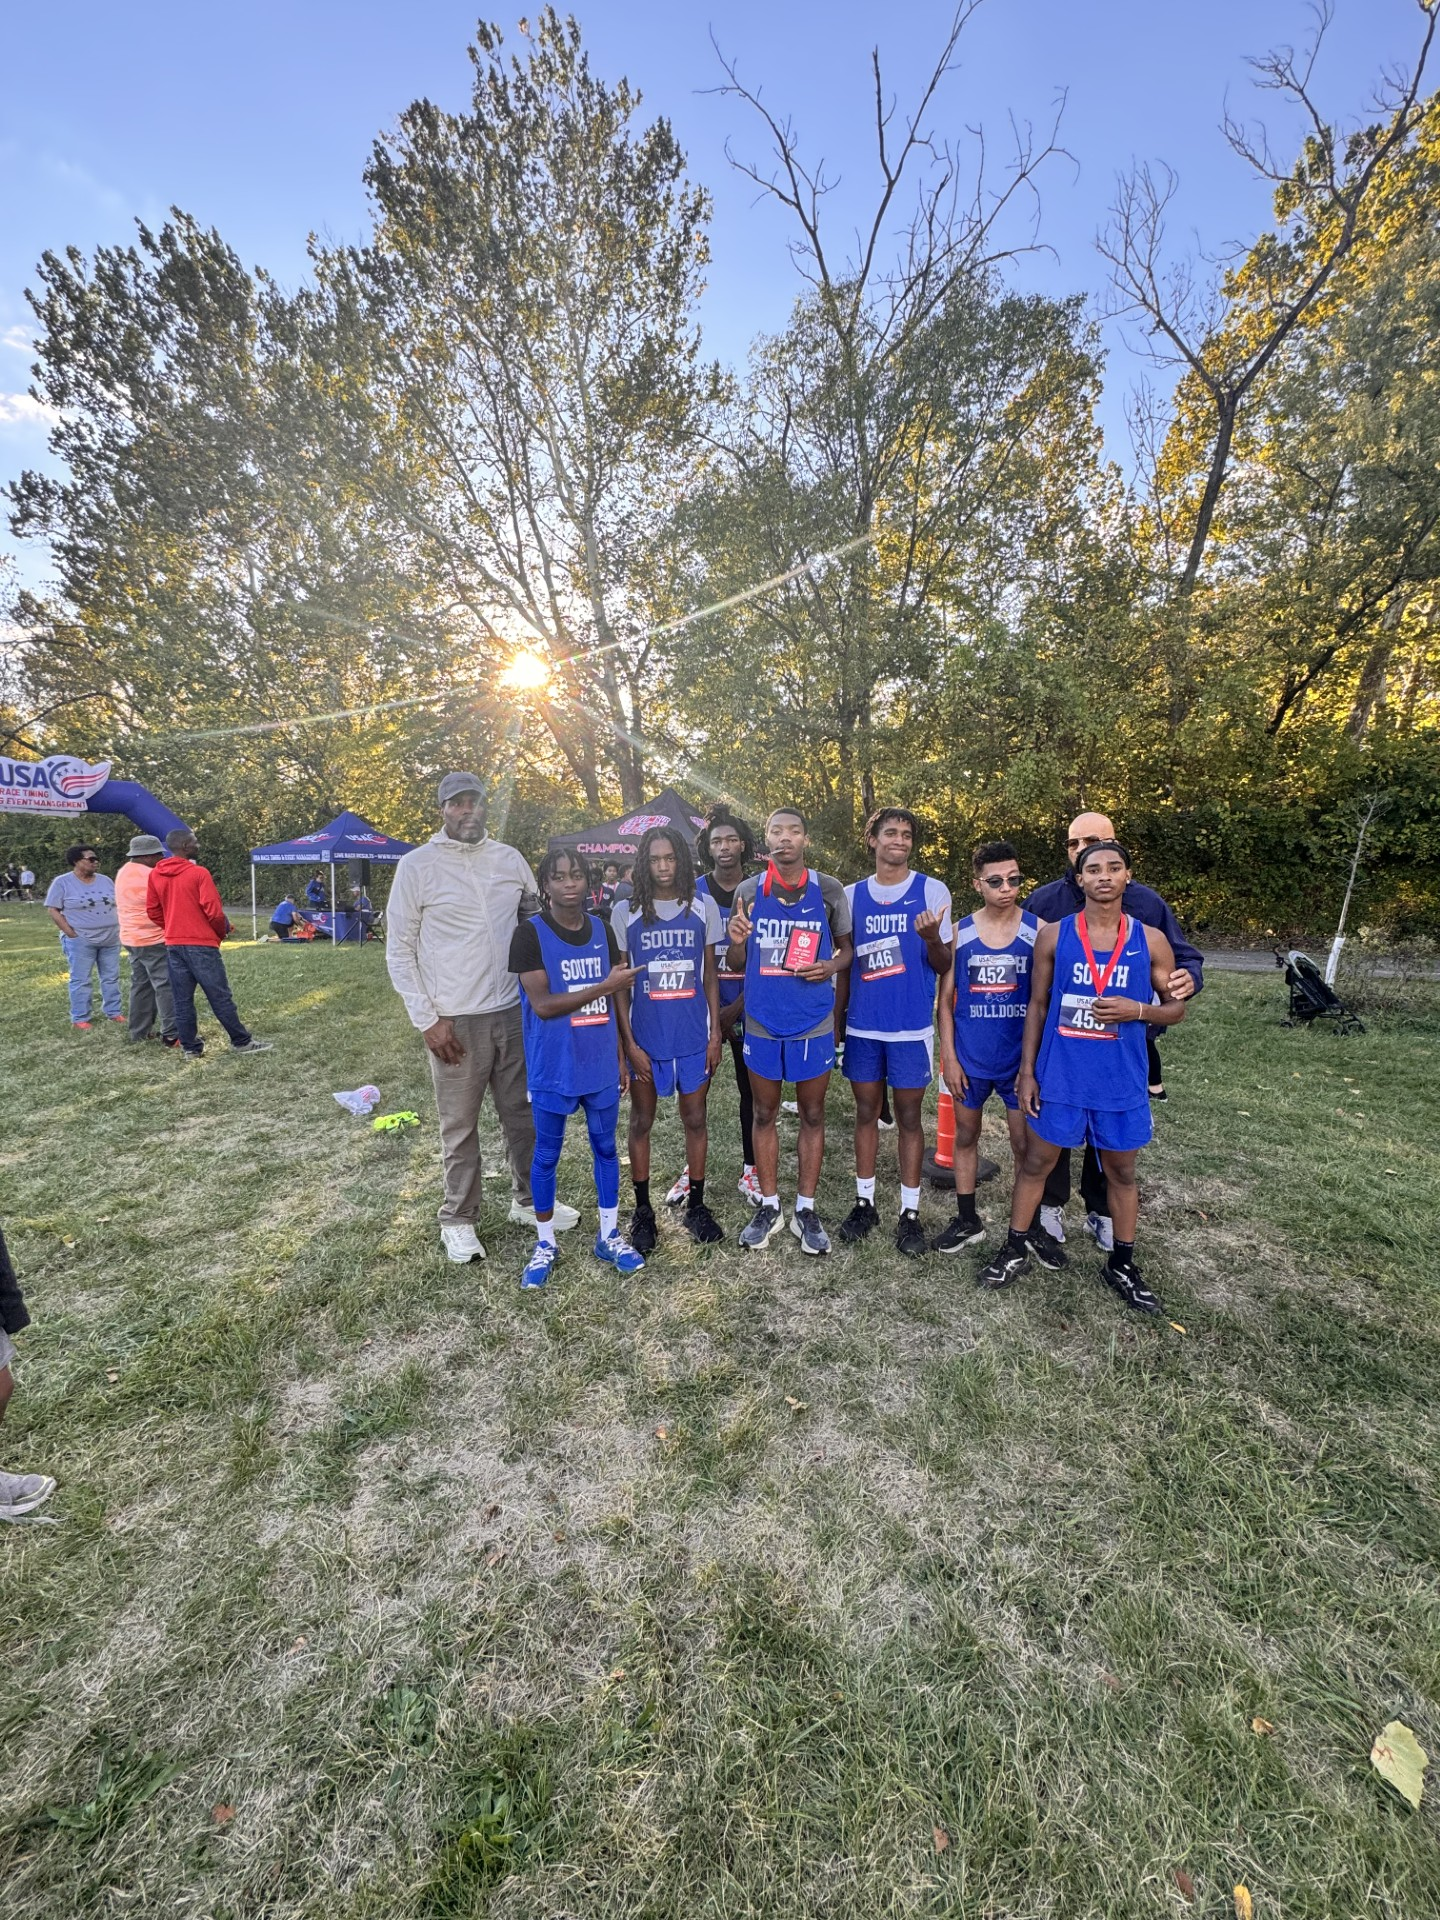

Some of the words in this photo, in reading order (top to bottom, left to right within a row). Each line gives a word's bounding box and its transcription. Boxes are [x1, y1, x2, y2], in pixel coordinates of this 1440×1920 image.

[0, 763, 50, 789] USA
[23, 789, 49, 798] TIMING
[33, 799, 86, 808] MANAGEMENT
[865, 913, 908, 934] SOUTH
[640, 929, 695, 951] SOUTH
[561, 957, 602, 981] SOUTH
[868, 949, 894, 970] 446
[658, 971, 686, 990] 447
[977, 966, 1007, 984] 452
[580, 995, 608, 1015] 448
[969, 1004, 1027, 1018] BULLDOGS
